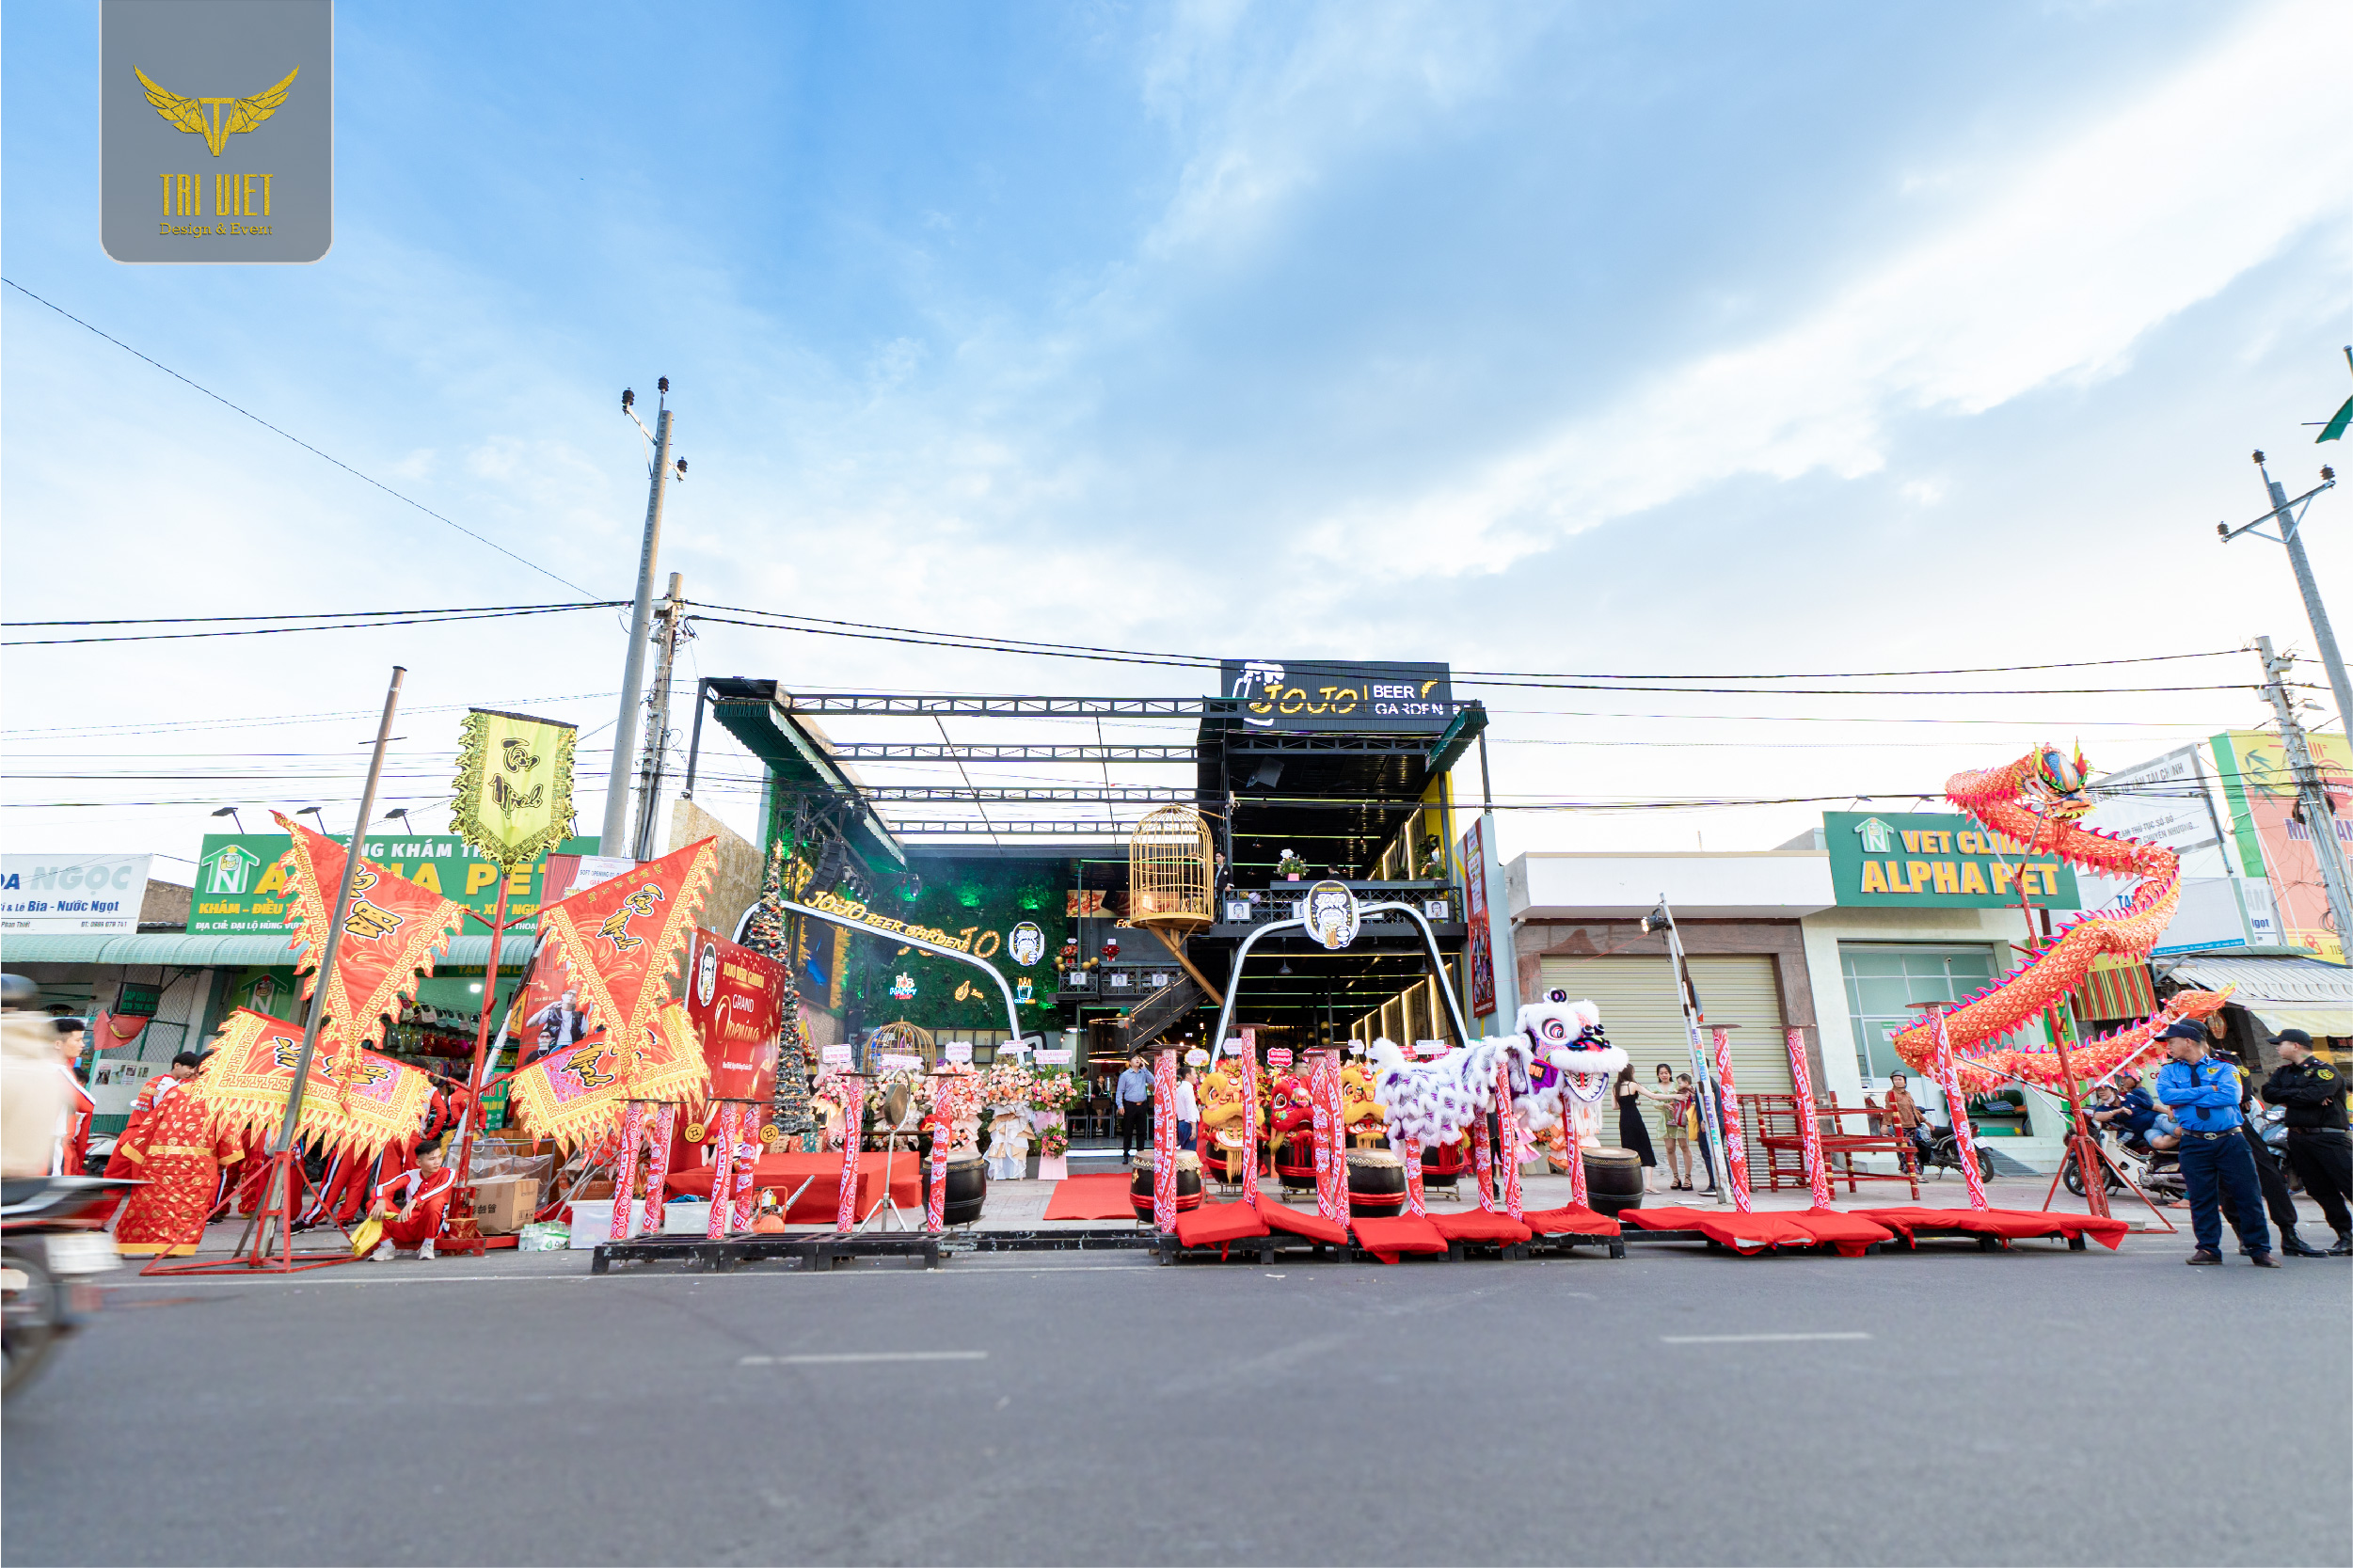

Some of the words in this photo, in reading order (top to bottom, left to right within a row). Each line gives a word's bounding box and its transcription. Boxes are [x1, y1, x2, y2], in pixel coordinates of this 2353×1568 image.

[1373, 684, 1416, 699] BEER
[390, 838, 453, 858] KHÁM
[1899, 829, 1951, 854] VET
[29, 865, 133, 895] NGỌC
[1860, 861, 1989, 895] ALPHA
[1988, 863, 2059, 895] PET
[26, 900, 48, 912] Bia
[56, 899, 88, 912] Nước
[90, 900, 119, 913] Ngọt
[199, 898, 241, 914] KHÁM
[251, 897, 283, 914] ĐIỀU
[1316, 895, 1345, 905] JOJO
[196, 922, 210, 930] ĐỊA
[230, 922, 246, 930] ĐẠI
[246, 921, 258, 930] LỘ
[260, 921, 283, 929] HÙNG
[803, 891, 867, 920] JOJO
[864, 912, 904, 933] BEER
[904, 924, 968, 951] GARDEN
[732, 993, 755, 1013] GRAND
[715, 994, 759, 1062] Opening
